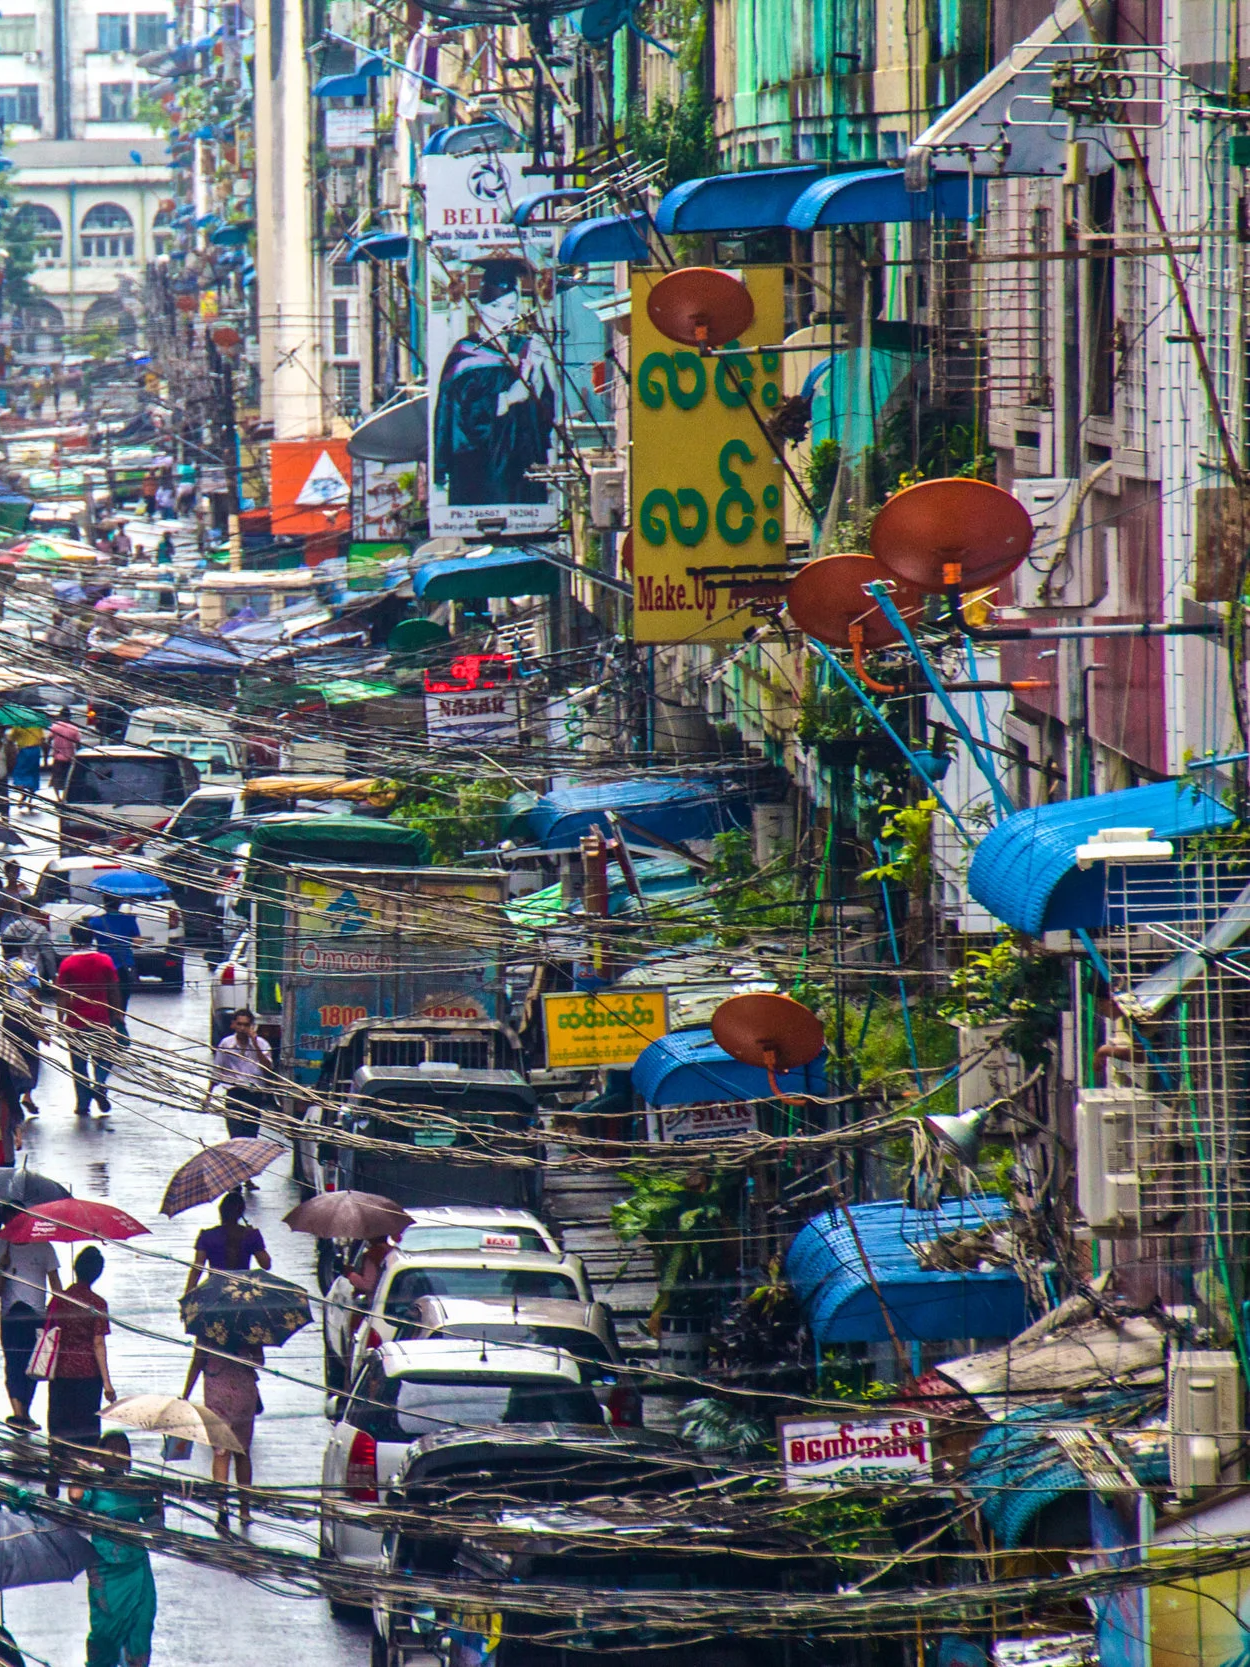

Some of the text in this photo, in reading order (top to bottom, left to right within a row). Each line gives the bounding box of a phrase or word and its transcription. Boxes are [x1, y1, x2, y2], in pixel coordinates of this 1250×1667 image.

[482, 228, 490, 239] &
[639, 439, 780, 547] လင်း
[486, 1237, 515, 1247] TAXI
